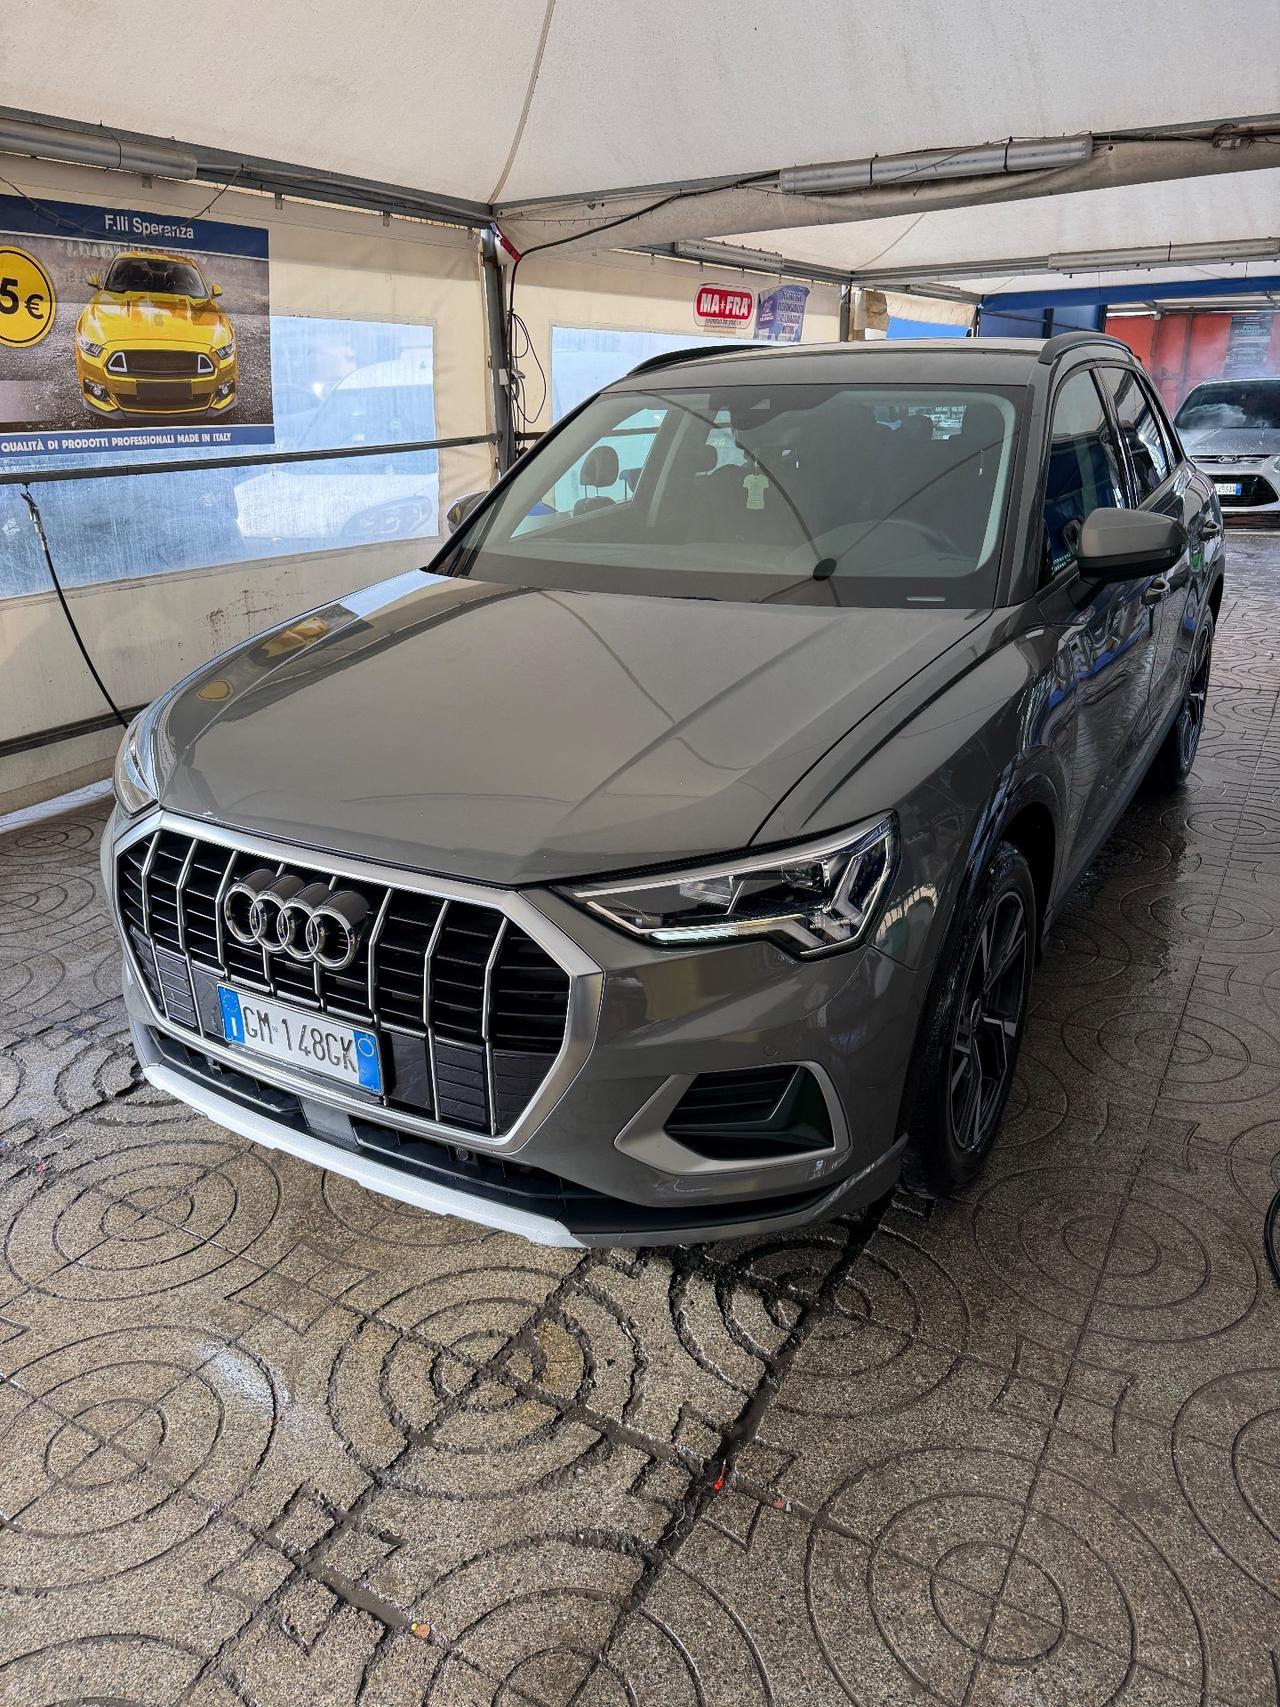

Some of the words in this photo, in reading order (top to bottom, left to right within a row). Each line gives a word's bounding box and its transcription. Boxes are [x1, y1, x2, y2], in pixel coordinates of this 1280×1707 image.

[132, 216, 194, 239] Speranza
[1, 438, 44, 452] QUALITÀ
[48, 439, 58, 450] DI
[62, 437, 108, 449] PRODOTTI
[111, 434, 174, 447] PROFESSIONALI
[177, 433, 199, 443] MADE
[202, 433, 210, 442] IN
[212, 432, 232, 441] ITALY
